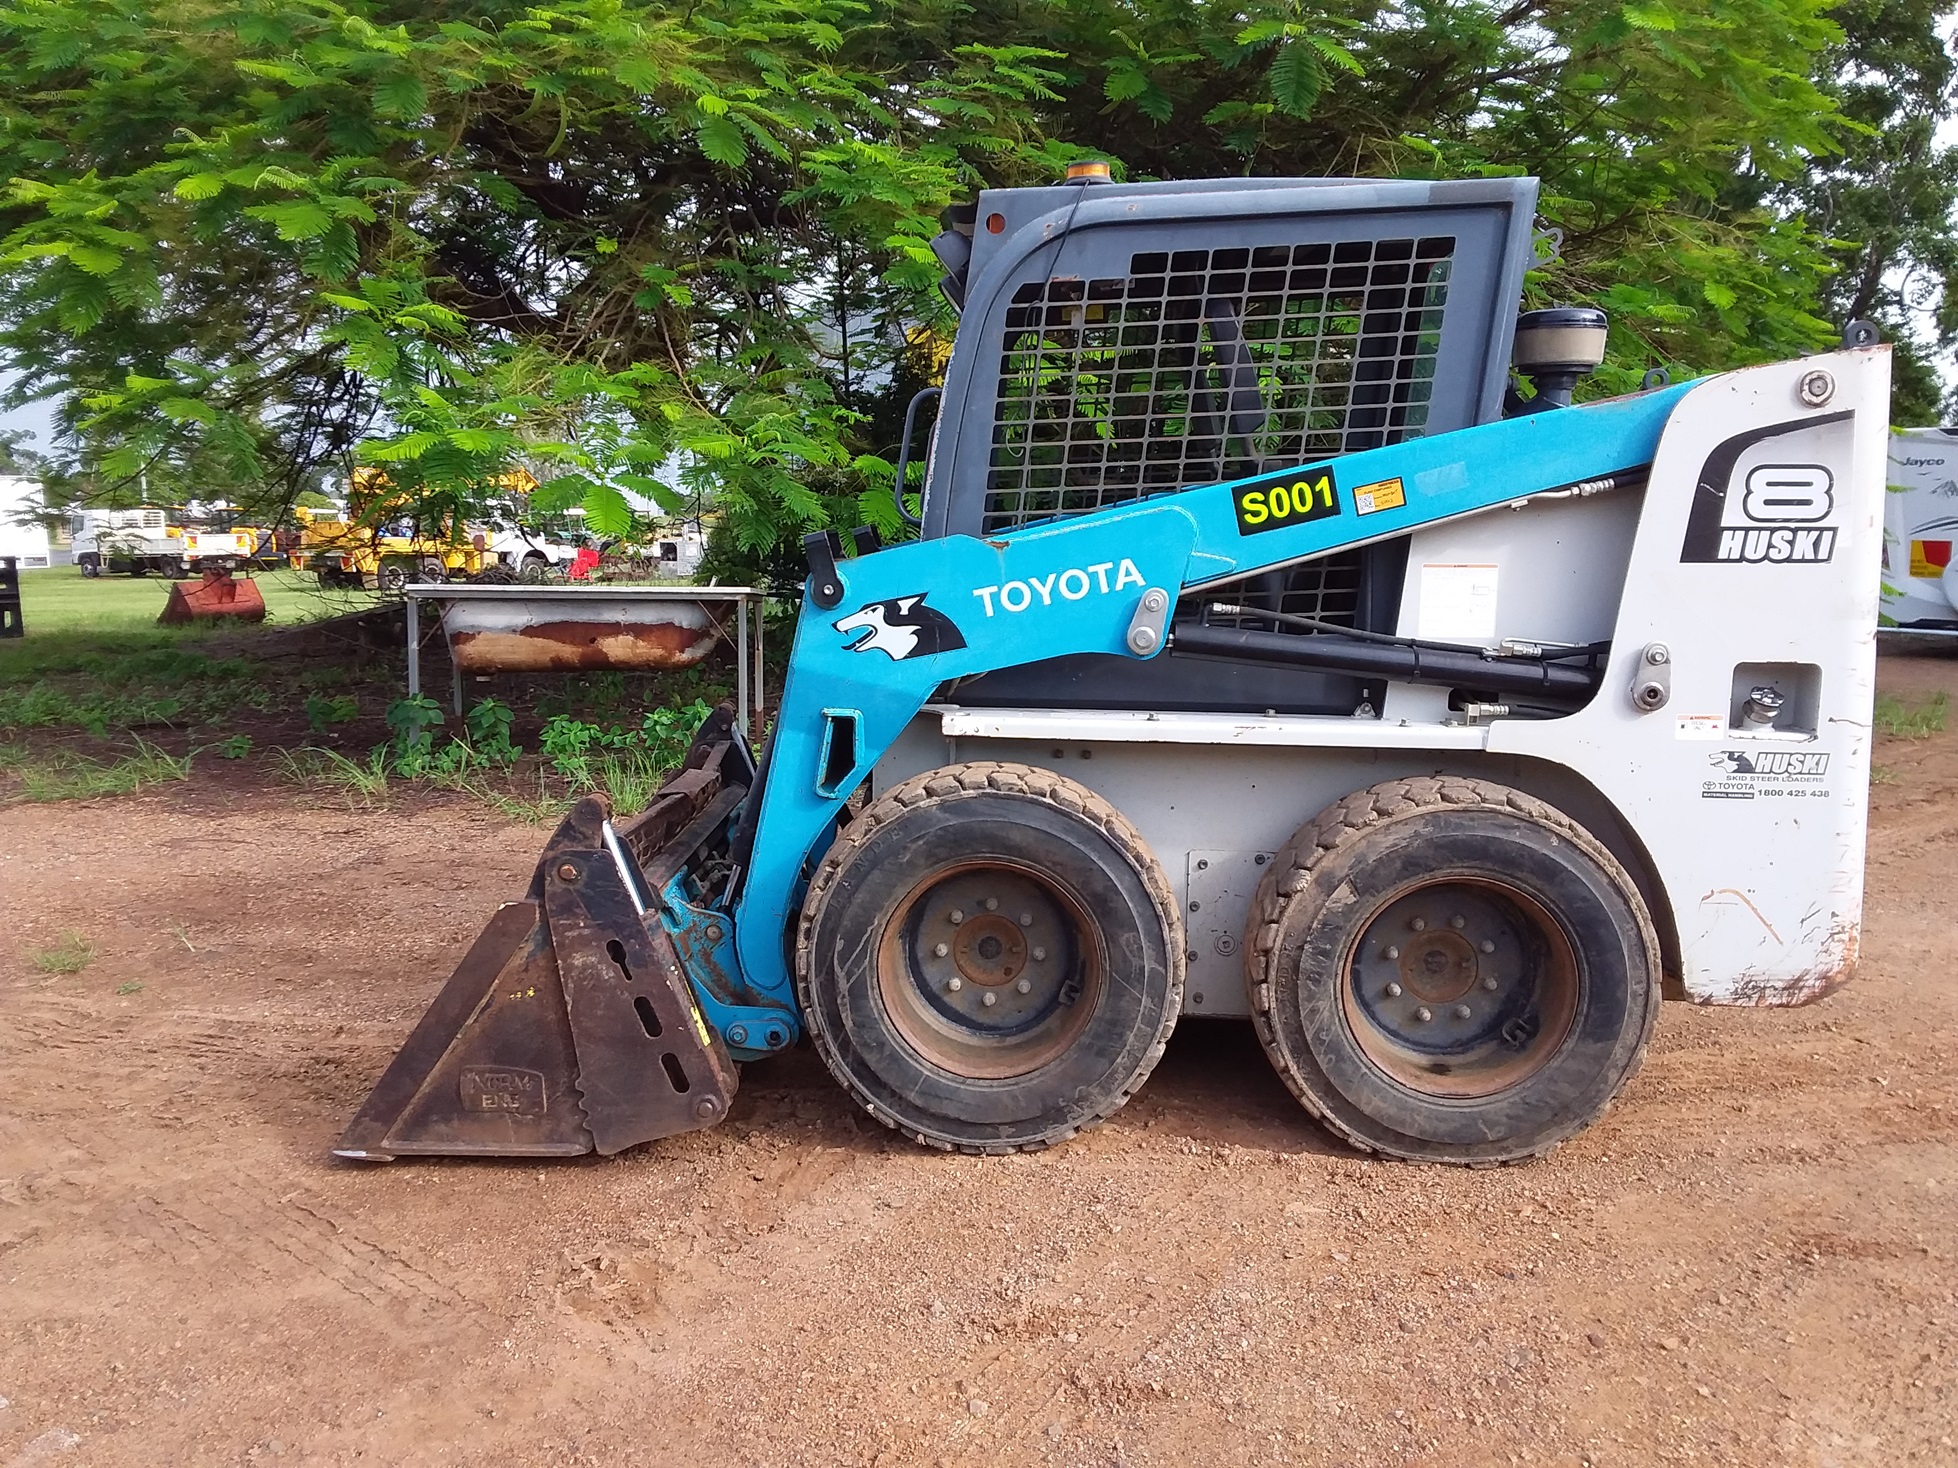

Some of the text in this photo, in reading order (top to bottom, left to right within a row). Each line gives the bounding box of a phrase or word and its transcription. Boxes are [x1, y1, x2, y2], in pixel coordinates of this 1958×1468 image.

[1903, 456, 1946, 468] Jayco
[1240, 474, 1334, 525] S001
[1742, 463, 1835, 523] 8
[1717, 529, 1834, 561] HUSKI
[972, 557, 1147, 618] TOYOTA
[1755, 752, 1829, 775] HUSKI
[1717, 782, 1755, 791] TOYOTA
[1757, 789, 1830, 798] 1800 425 438
